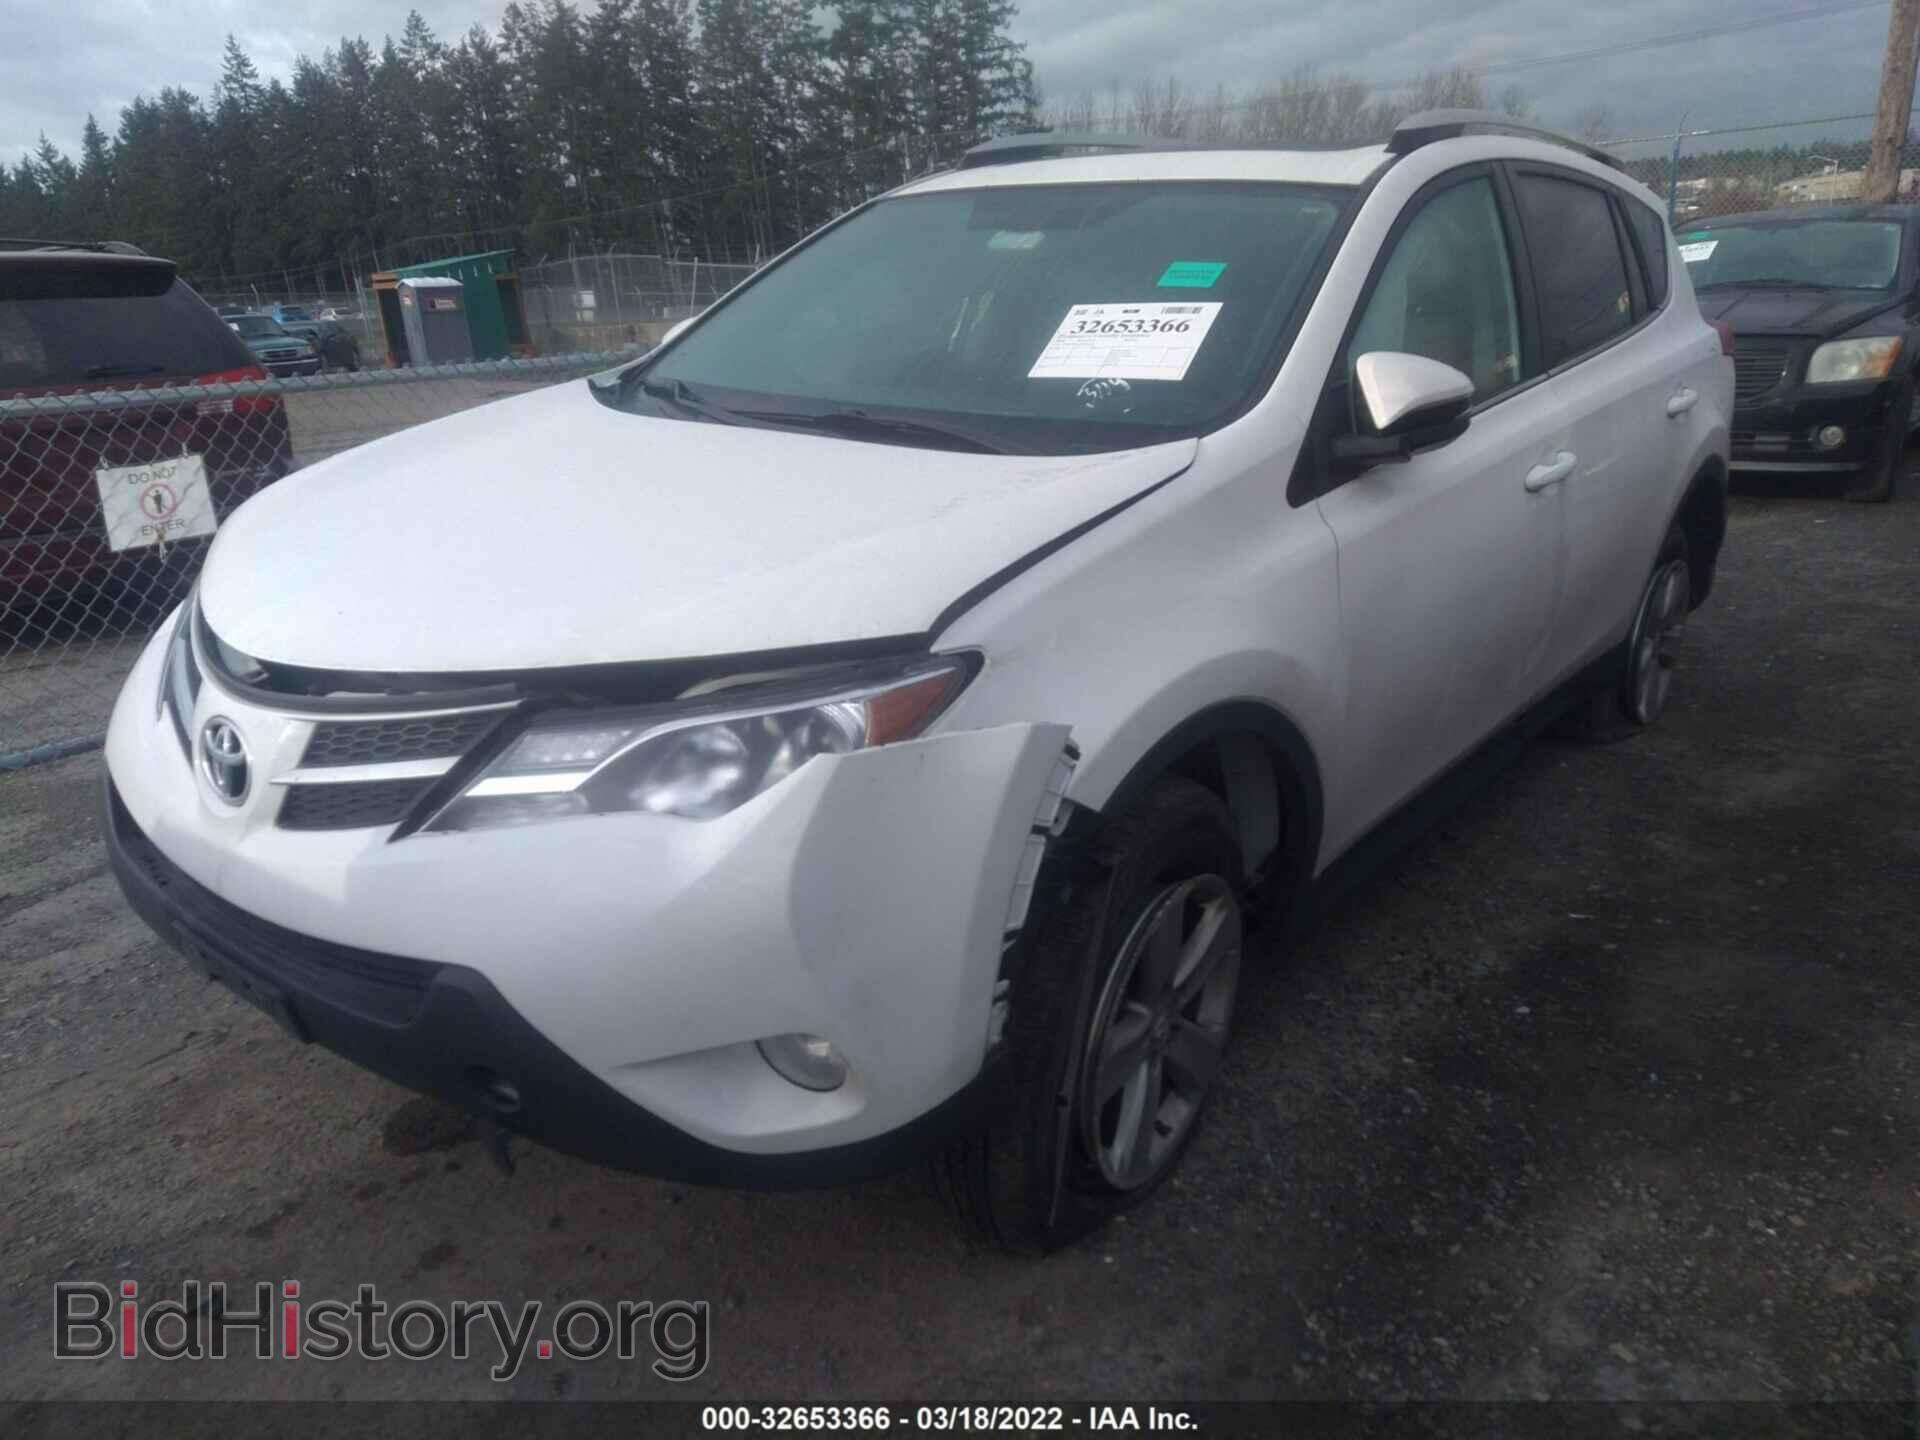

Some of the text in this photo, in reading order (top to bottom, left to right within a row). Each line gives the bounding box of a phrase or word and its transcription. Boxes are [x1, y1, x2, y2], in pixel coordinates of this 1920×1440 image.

[1071, 319, 1191, 334] 32653366
[128, 466, 176, 485] DO NOT
